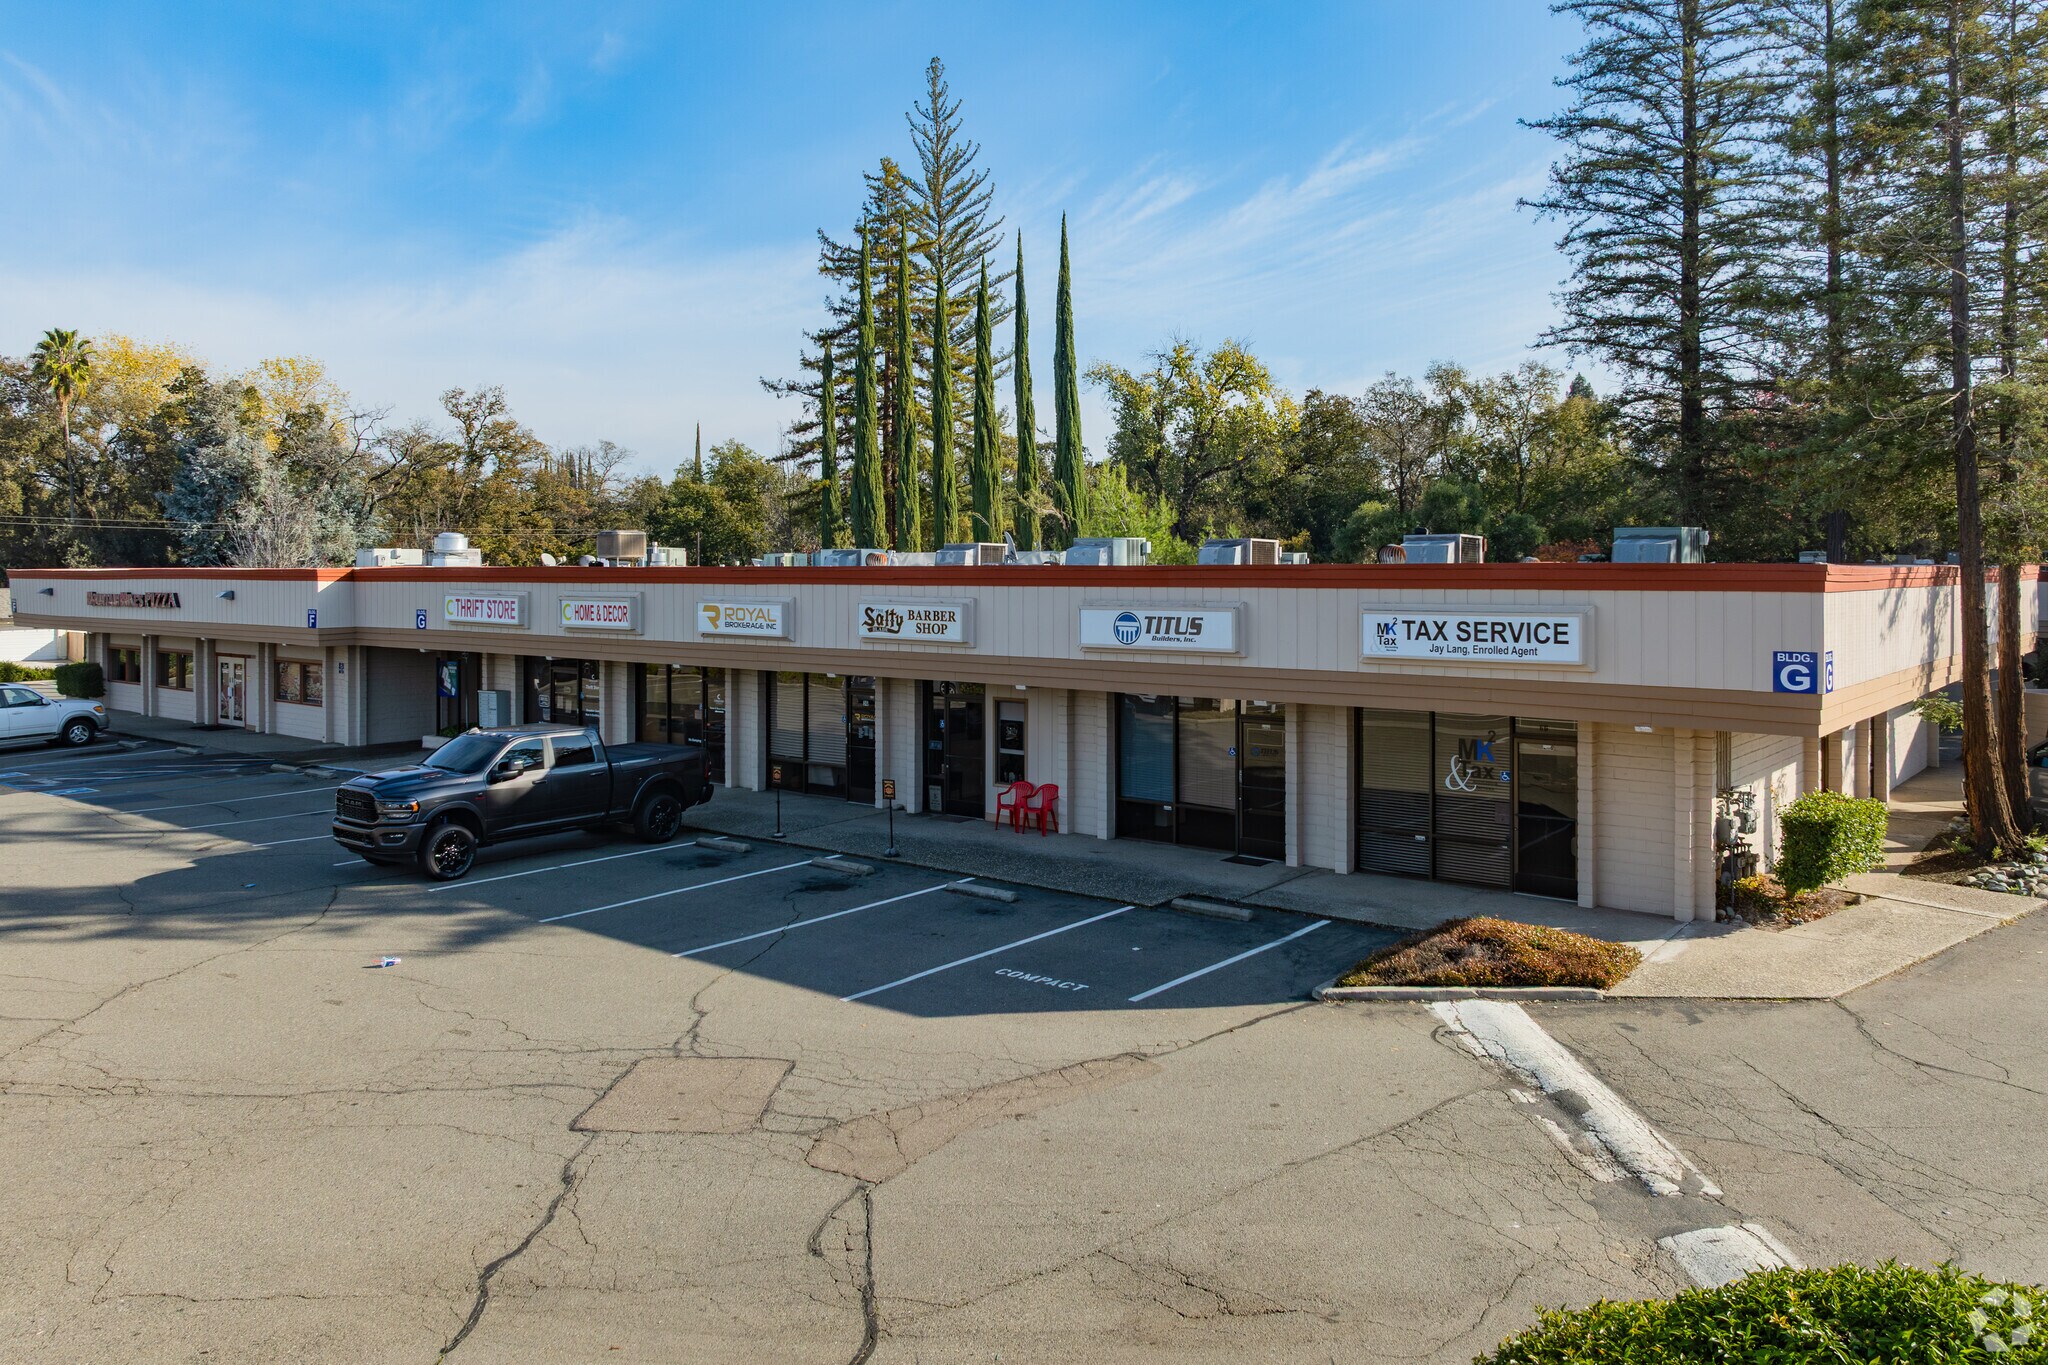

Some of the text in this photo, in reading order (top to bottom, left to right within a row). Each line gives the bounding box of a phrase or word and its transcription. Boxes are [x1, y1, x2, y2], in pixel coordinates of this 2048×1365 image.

[456, 598, 484, 618] THRIFT
[486, 600, 516, 620] STORE
[574, 604, 594, 621] HOME
[596, 604, 601, 621] &
[603, 605, 628, 622] DECOR
[724, 607, 776, 622] ROYAL
[907, 610, 956, 622] BARBER
[310, 615, 314, 627] F
[418, 616, 425, 628] G
[724, 621, 764, 630] BROKERAGE
[862, 607, 904, 634] Salty
[1144, 616, 1203, 635] TITUS
[916, 623, 948, 634] SHOP
[1402, 620, 1569, 645] TAX SERVICE
[1377, 635, 1397, 645] Tax
[1429, 644, 1538, 657] Jay Lang, Enrolled Agent
[1777, 653, 1813, 662] BLDG.
[1780, 664, 1810, 691] G
[1826, 664, 1832, 690] G
[995, 969, 1089, 991] COMPACT
